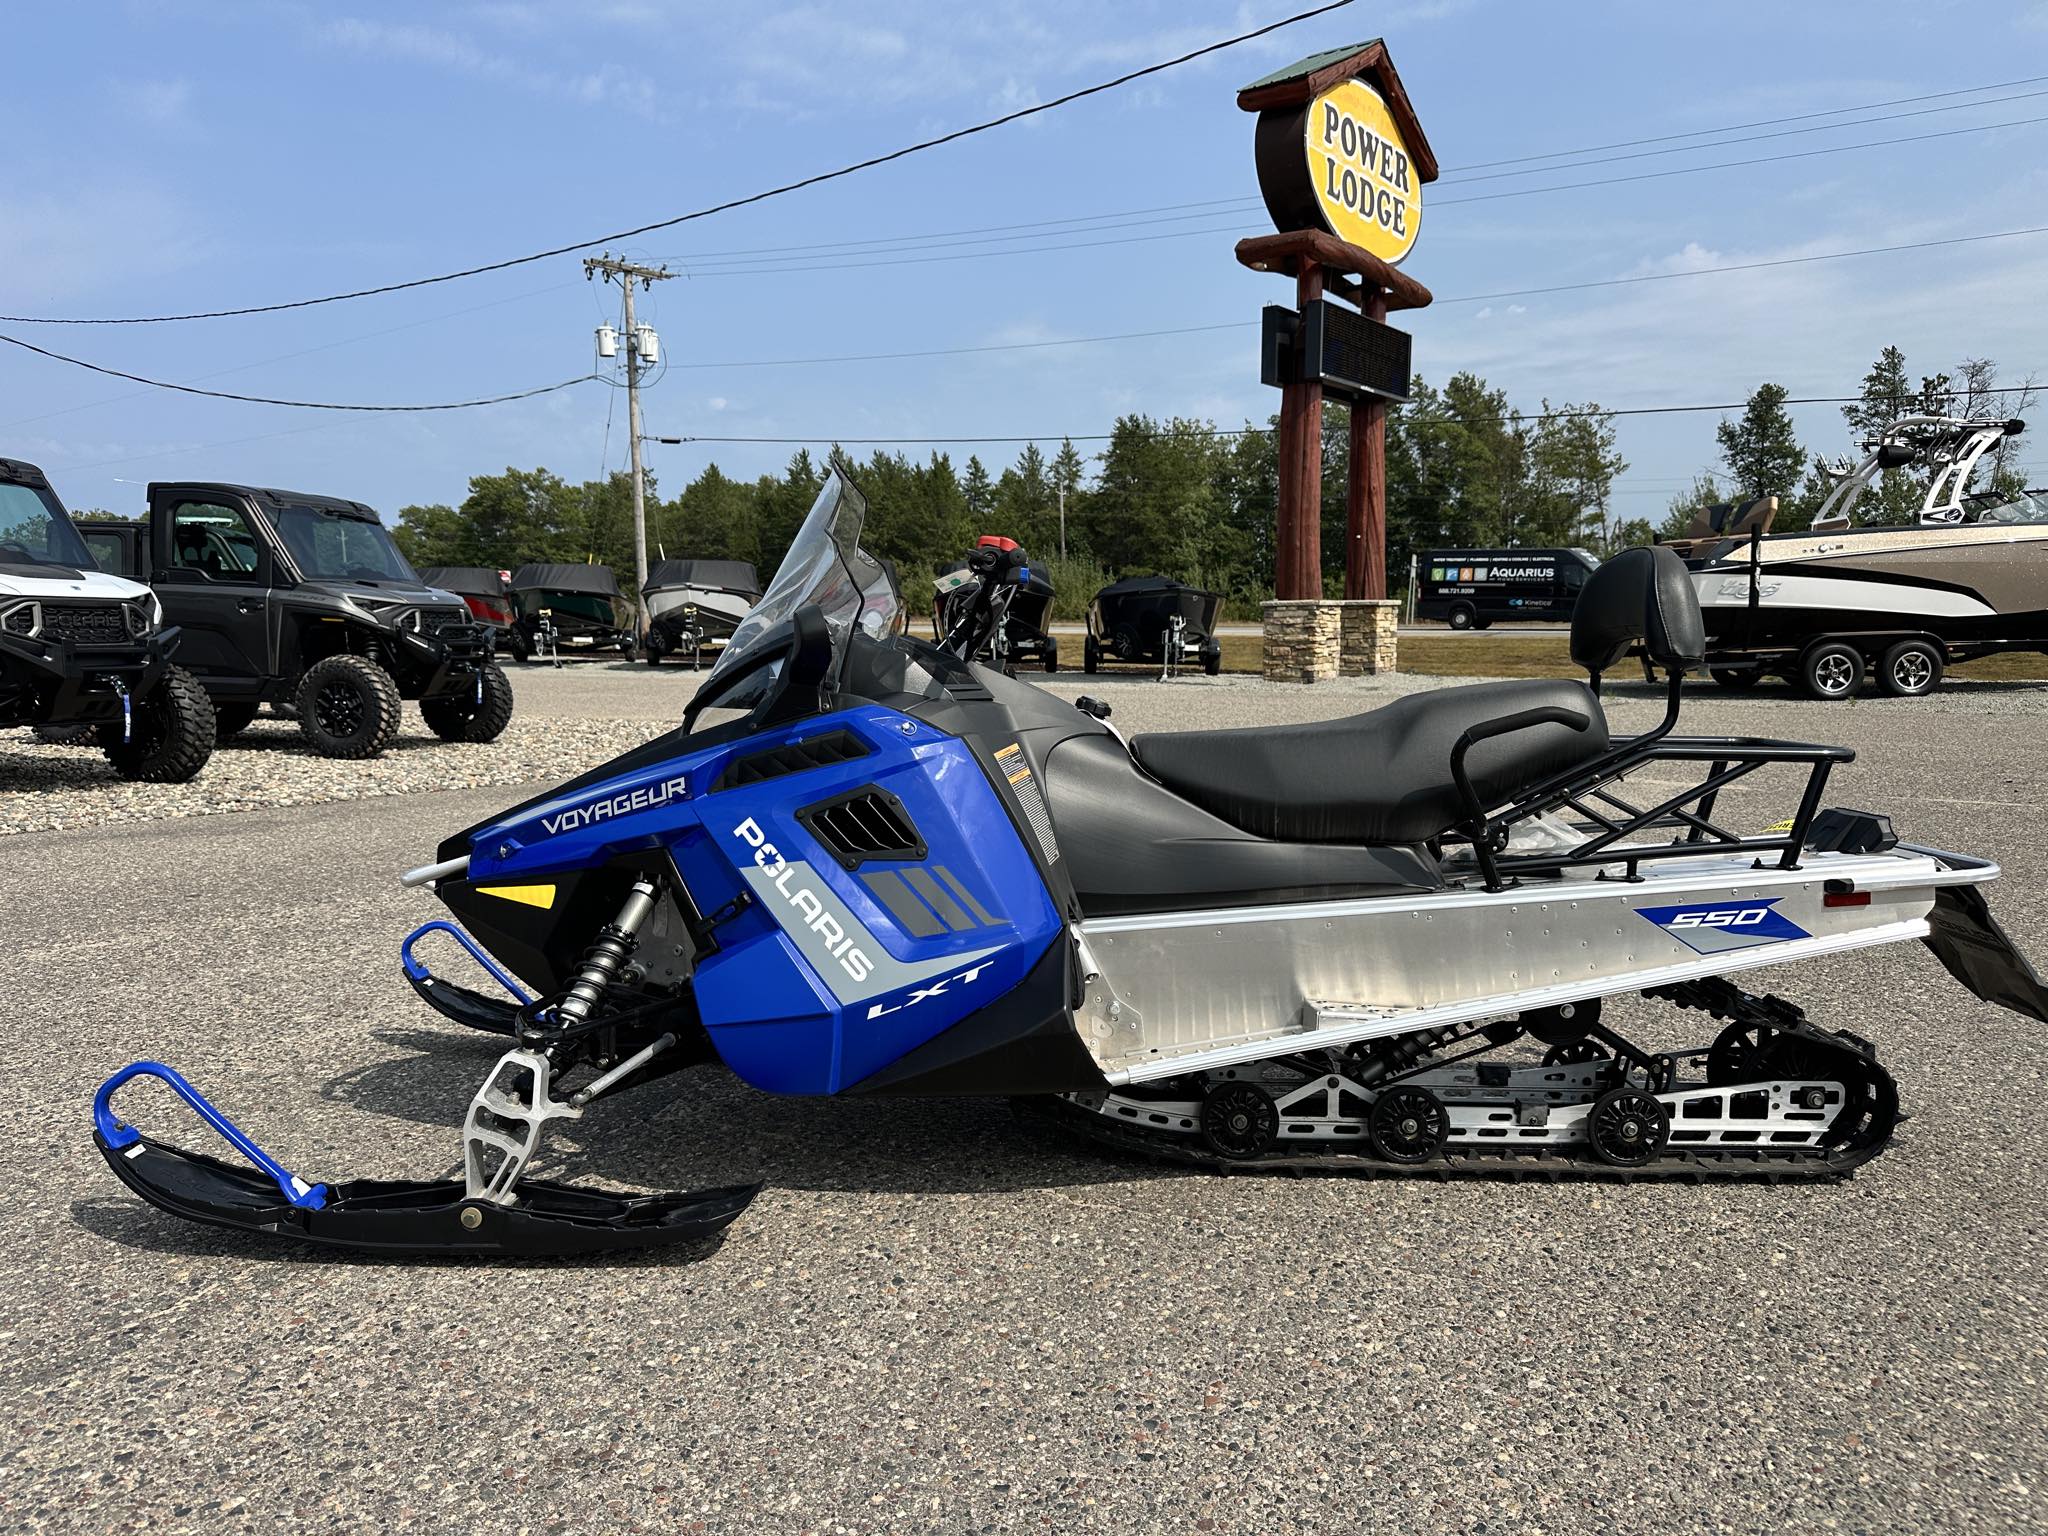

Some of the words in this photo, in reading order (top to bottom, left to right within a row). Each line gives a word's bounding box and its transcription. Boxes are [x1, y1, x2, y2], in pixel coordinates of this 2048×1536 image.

[1324, 102, 1409, 193] POWER
[1326, 157, 1406, 236] LODGE
[541, 776, 687, 834] VOYAGEUR
[733, 816, 875, 982] POLARIS
[1668, 908, 1767, 929] 550
[867, 960, 994, 1020] LXT
